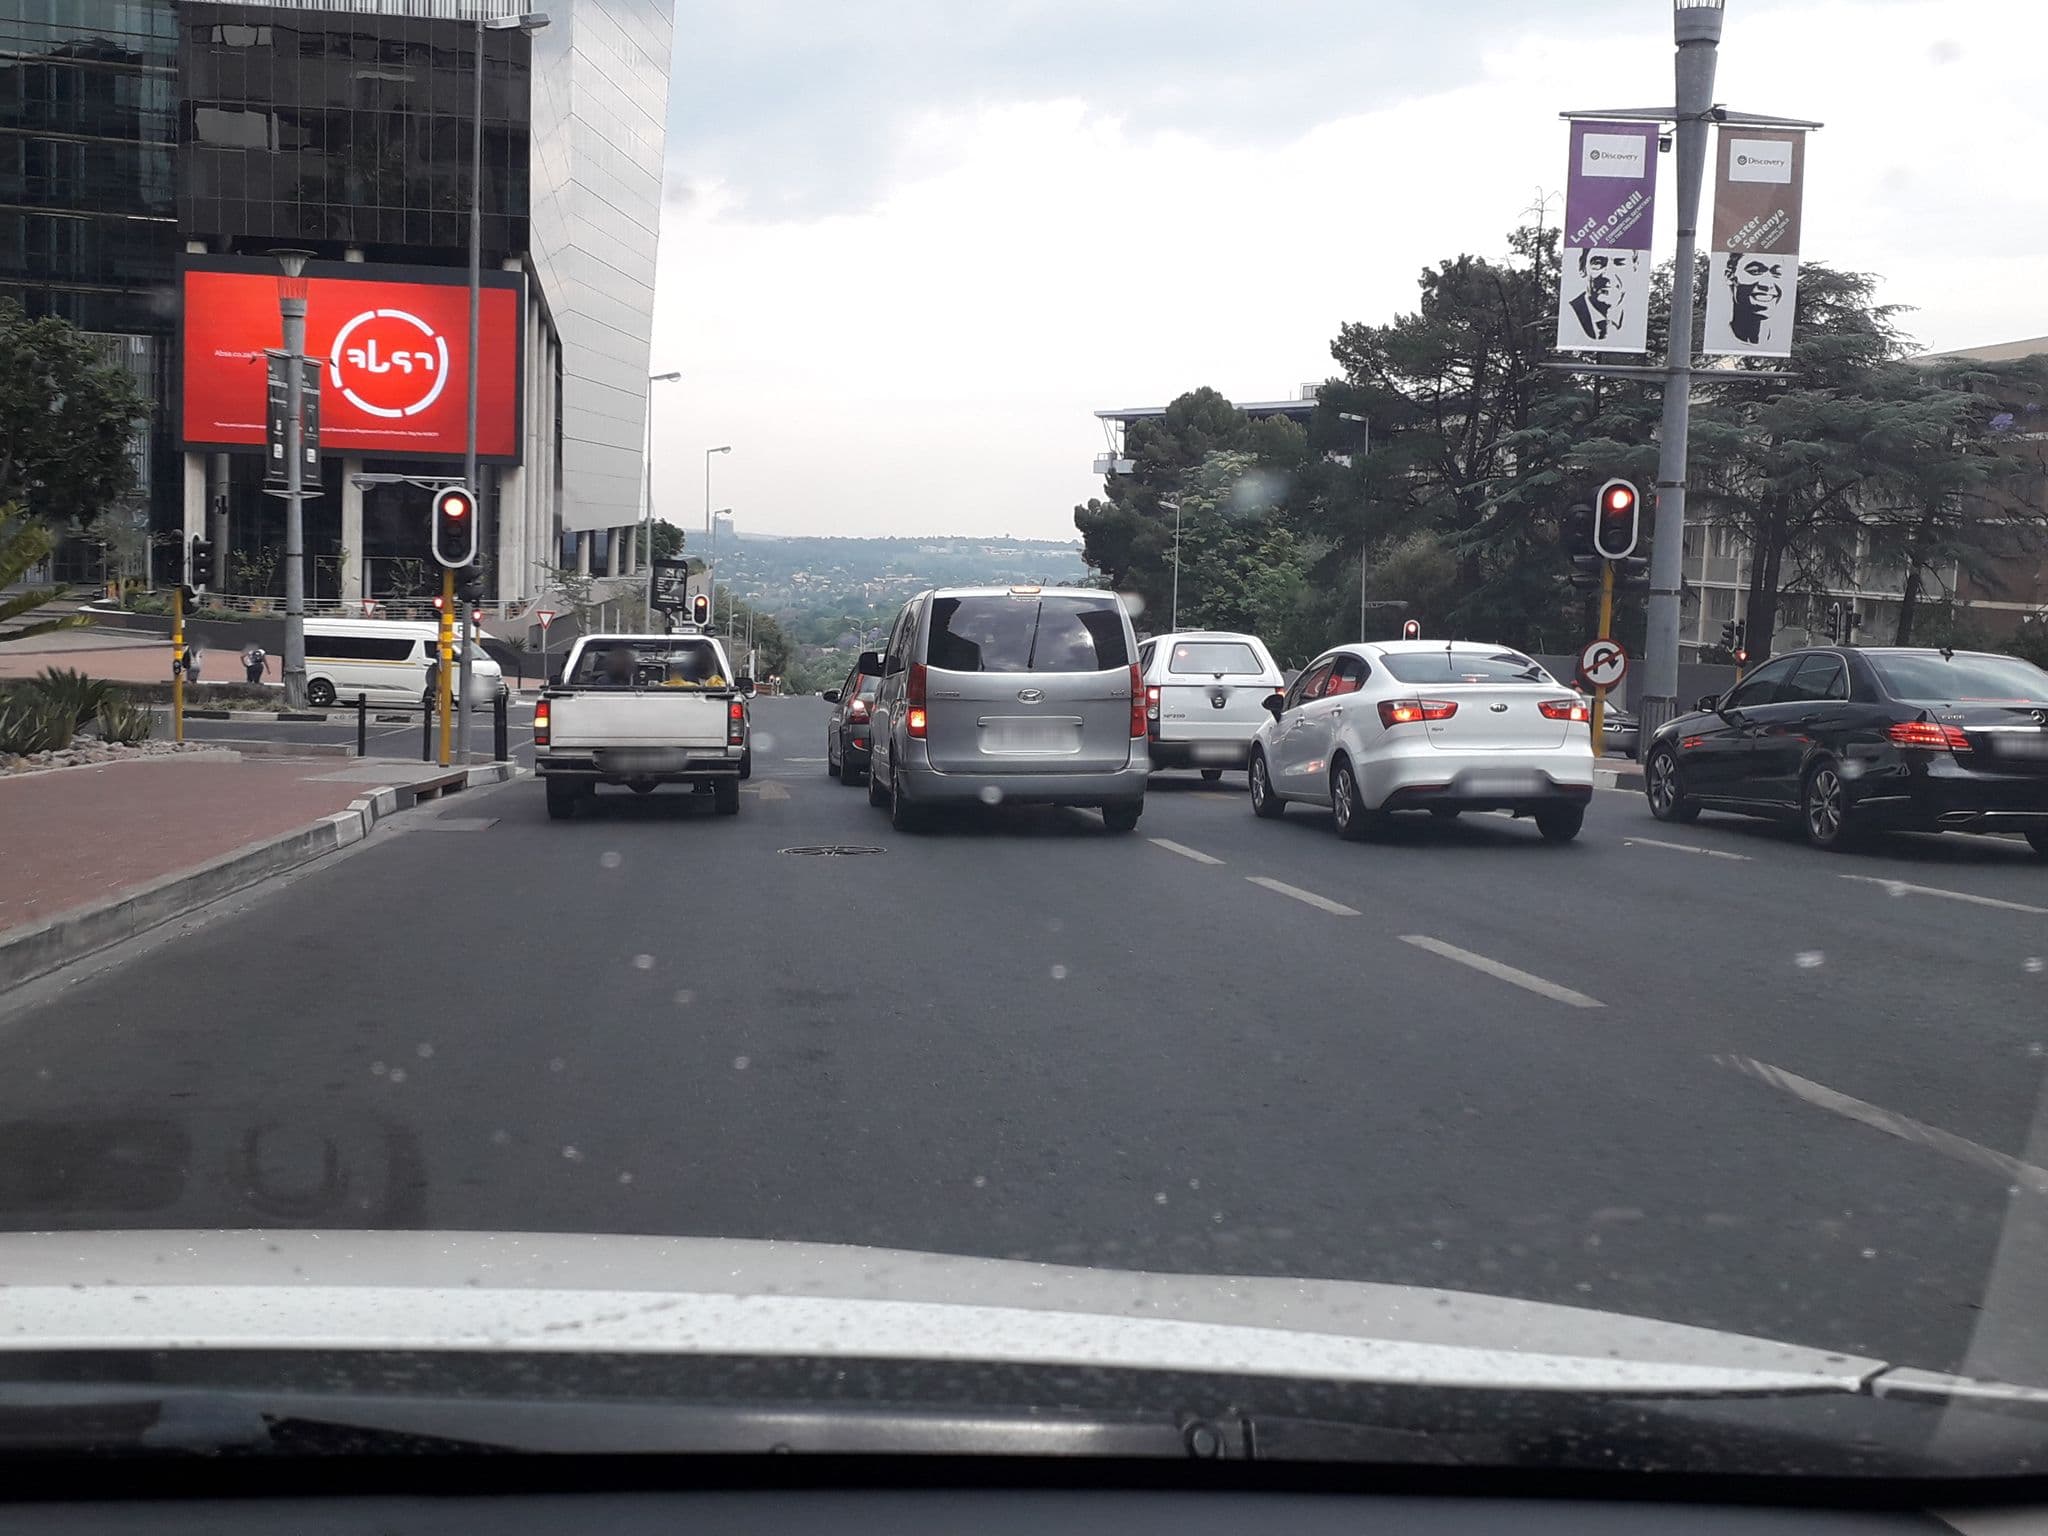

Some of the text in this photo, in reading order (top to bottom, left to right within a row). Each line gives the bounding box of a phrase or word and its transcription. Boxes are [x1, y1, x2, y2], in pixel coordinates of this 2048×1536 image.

[1601, 152, 1638, 161] Discovery
[1748, 157, 1785, 167] Discovery
[1570, 216, 1597, 243] Lord
[1589, 190, 1643, 246] Jim O'Neill
[1726, 215, 1760, 248] Caster
[1742, 209, 1785, 249] Semenya
[346, 339, 434, 374] absa
